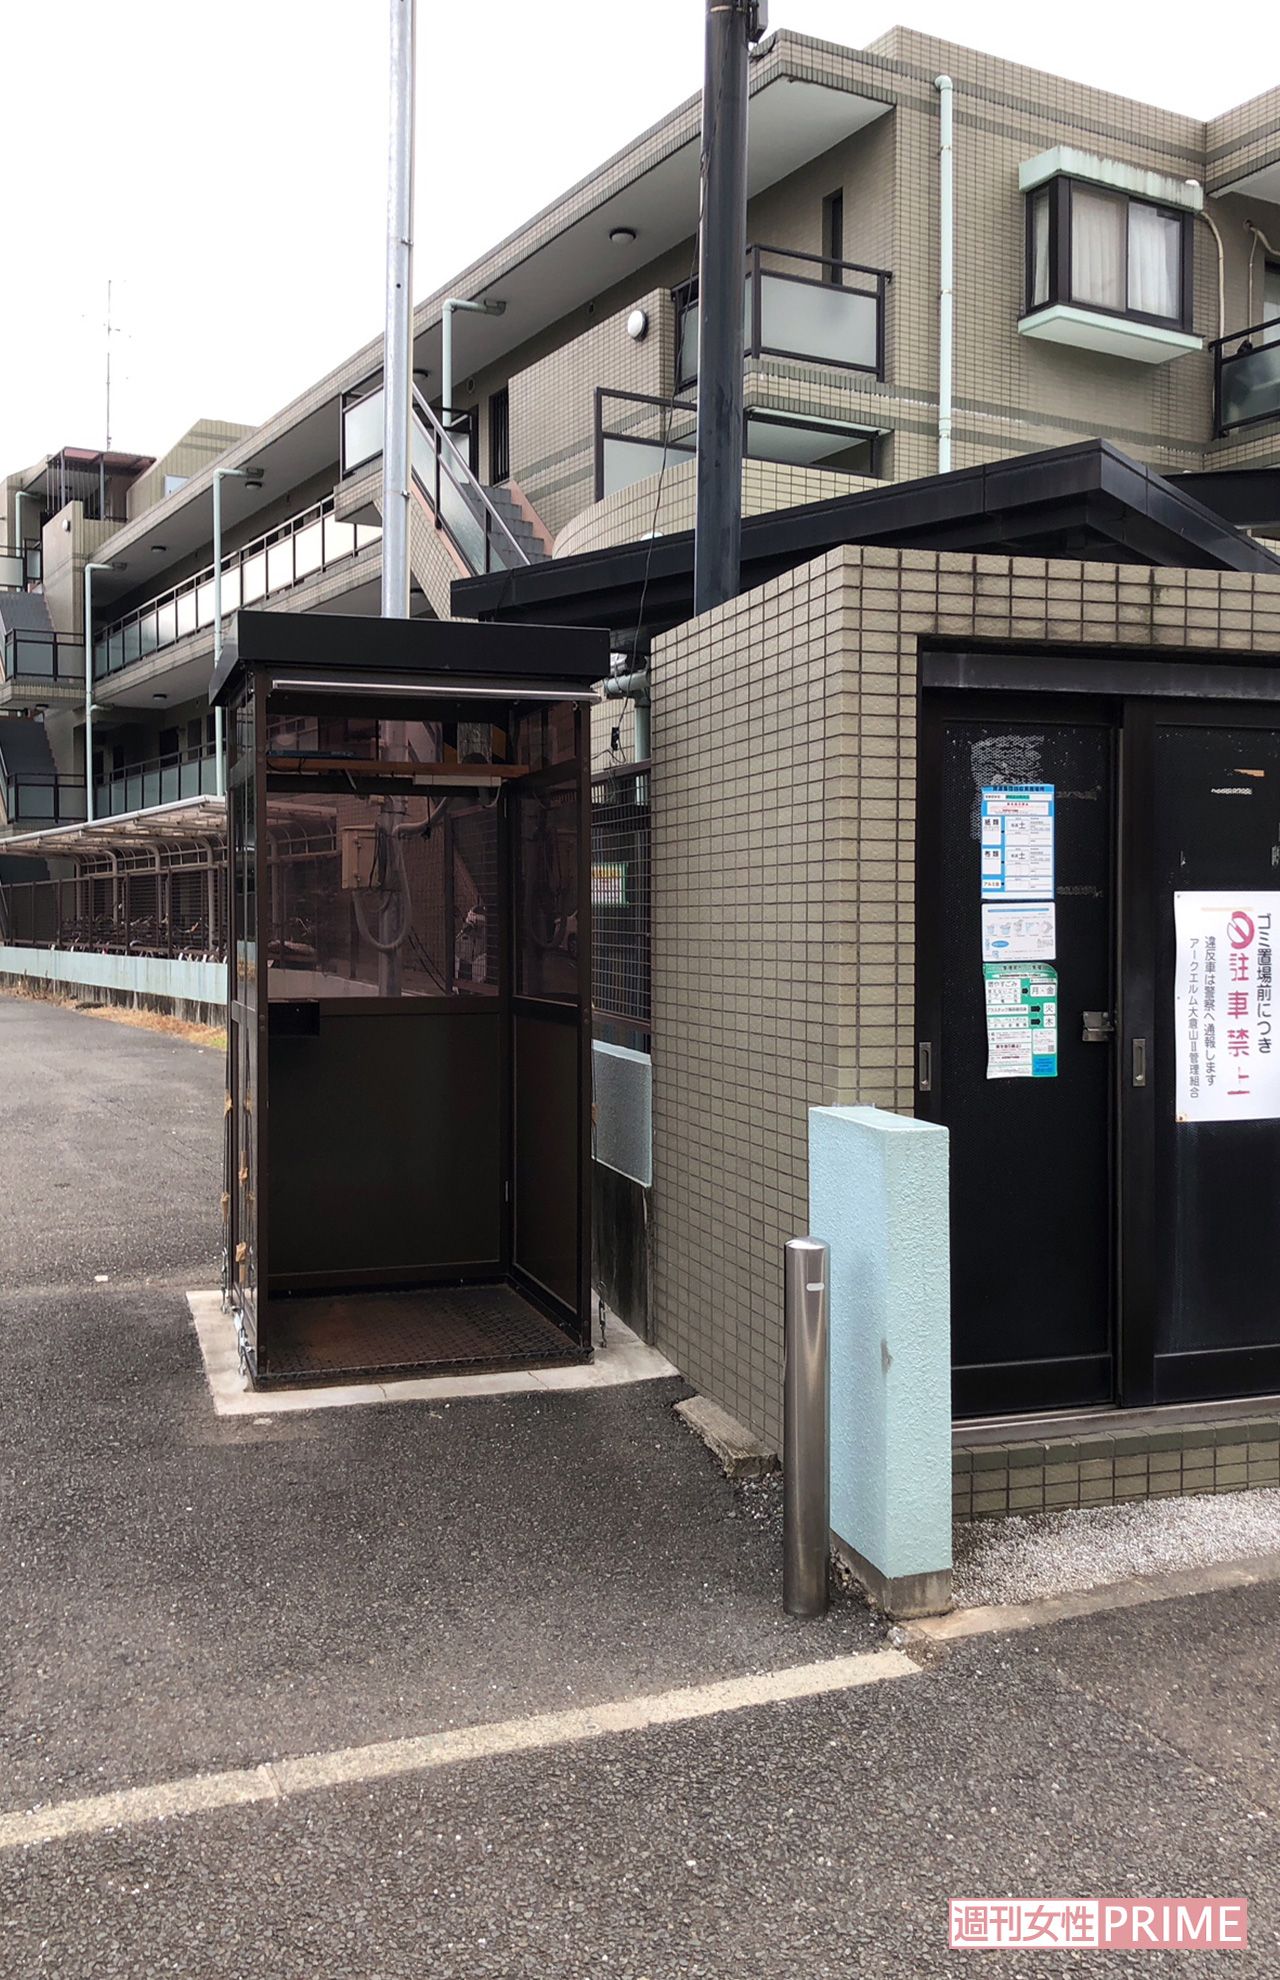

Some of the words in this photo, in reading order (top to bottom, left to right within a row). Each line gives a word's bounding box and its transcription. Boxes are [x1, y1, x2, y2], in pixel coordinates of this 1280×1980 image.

[1204, 935, 1216, 1087] 違反車は警察へ通報します
[1256, 912, 1272, 1054] ゴミ置場前につき
